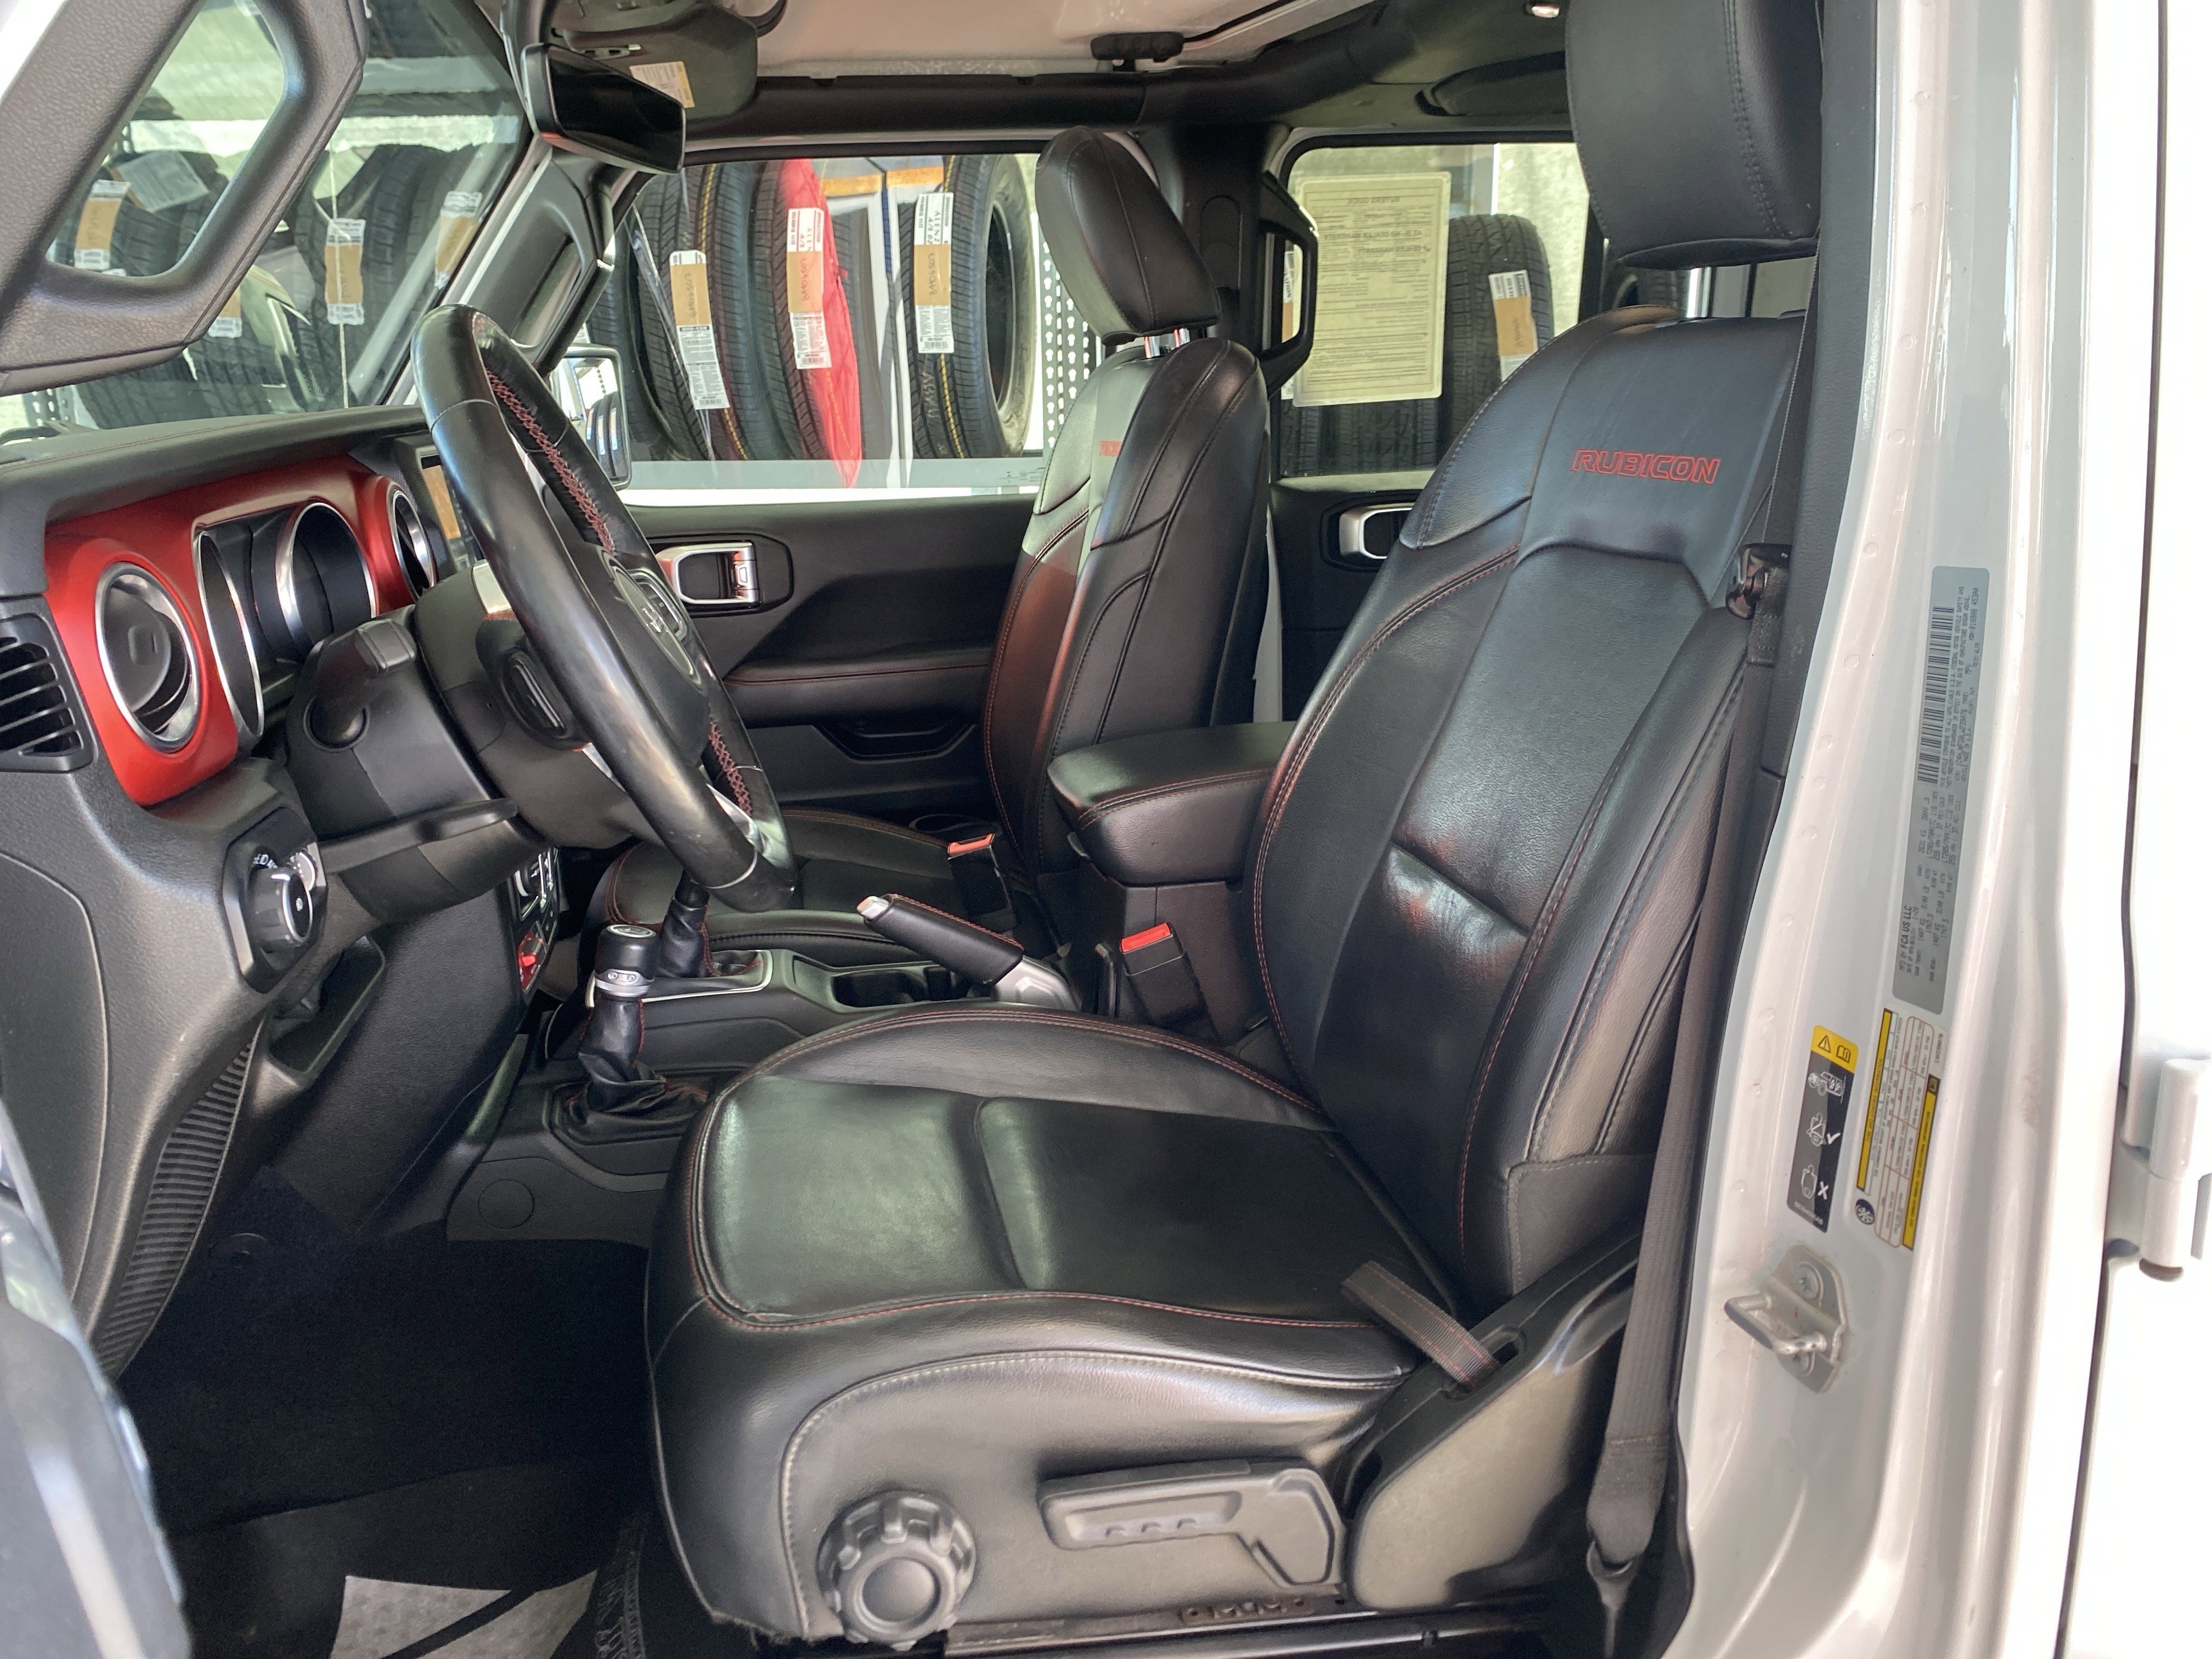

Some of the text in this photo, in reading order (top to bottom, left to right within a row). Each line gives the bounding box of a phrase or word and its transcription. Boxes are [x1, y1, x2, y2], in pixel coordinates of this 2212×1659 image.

[1570, 448, 1721, 484] RUBICON
[1903, 905, 1912, 919] LLC
[1902, 921, 1910, 932] US
[1900, 934, 1909, 949] FCA
